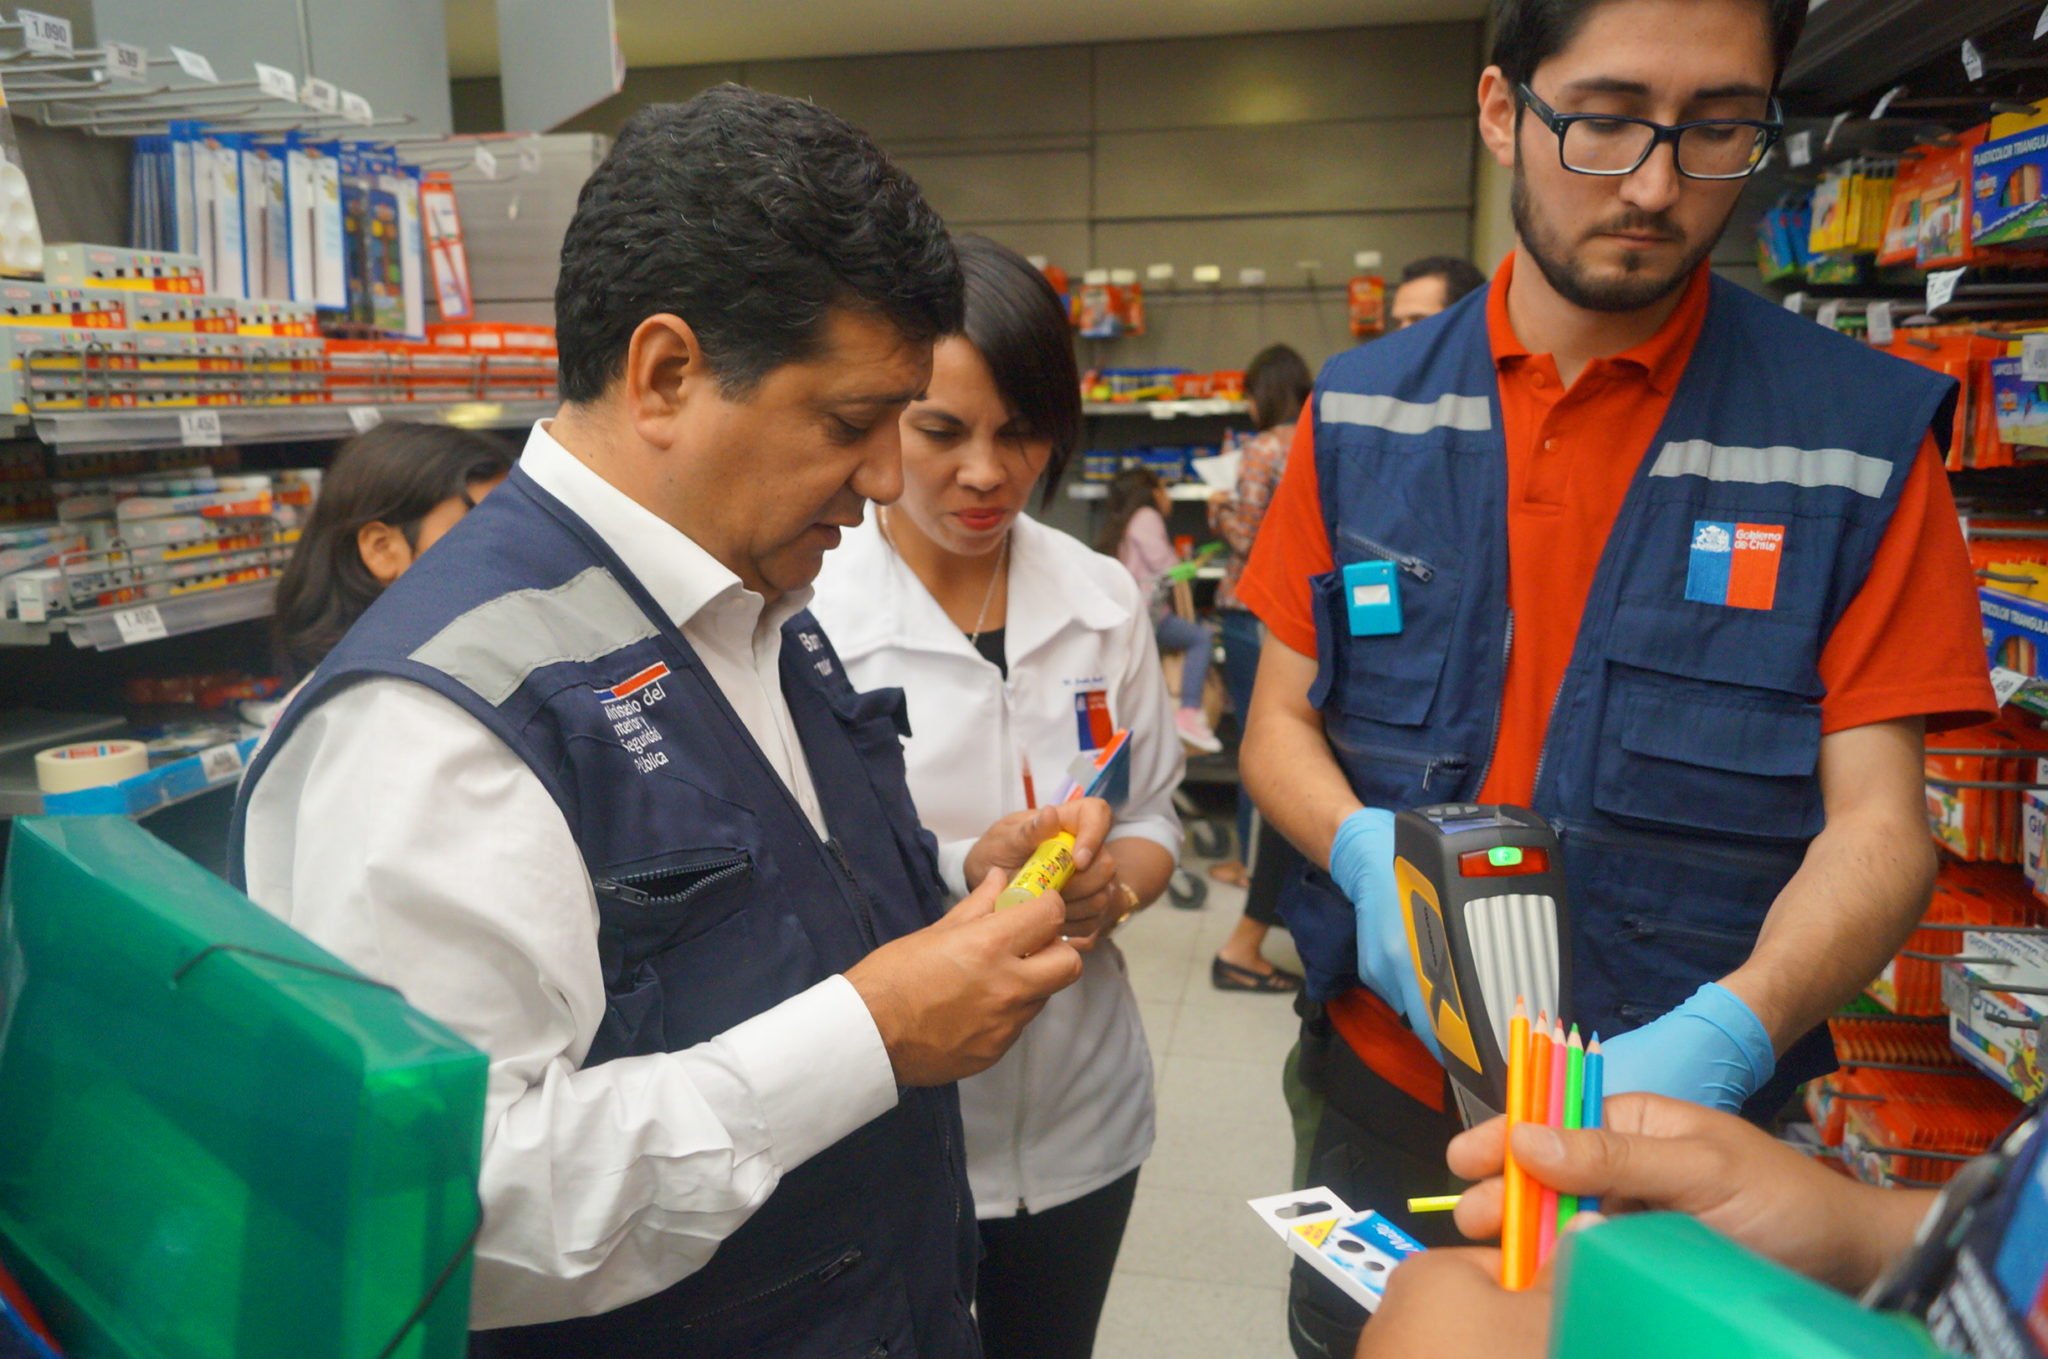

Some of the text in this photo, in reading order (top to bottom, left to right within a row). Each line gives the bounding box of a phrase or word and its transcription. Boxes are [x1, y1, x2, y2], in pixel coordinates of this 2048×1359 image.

[33, 21, 67, 42] 1.090
[2014, 134, 2048, 156] TRIANGUL
[1736, 528, 1782, 542] Gobierno
[1734, 540, 1776, 552] de Chile
[643, 680, 667, 706] del
